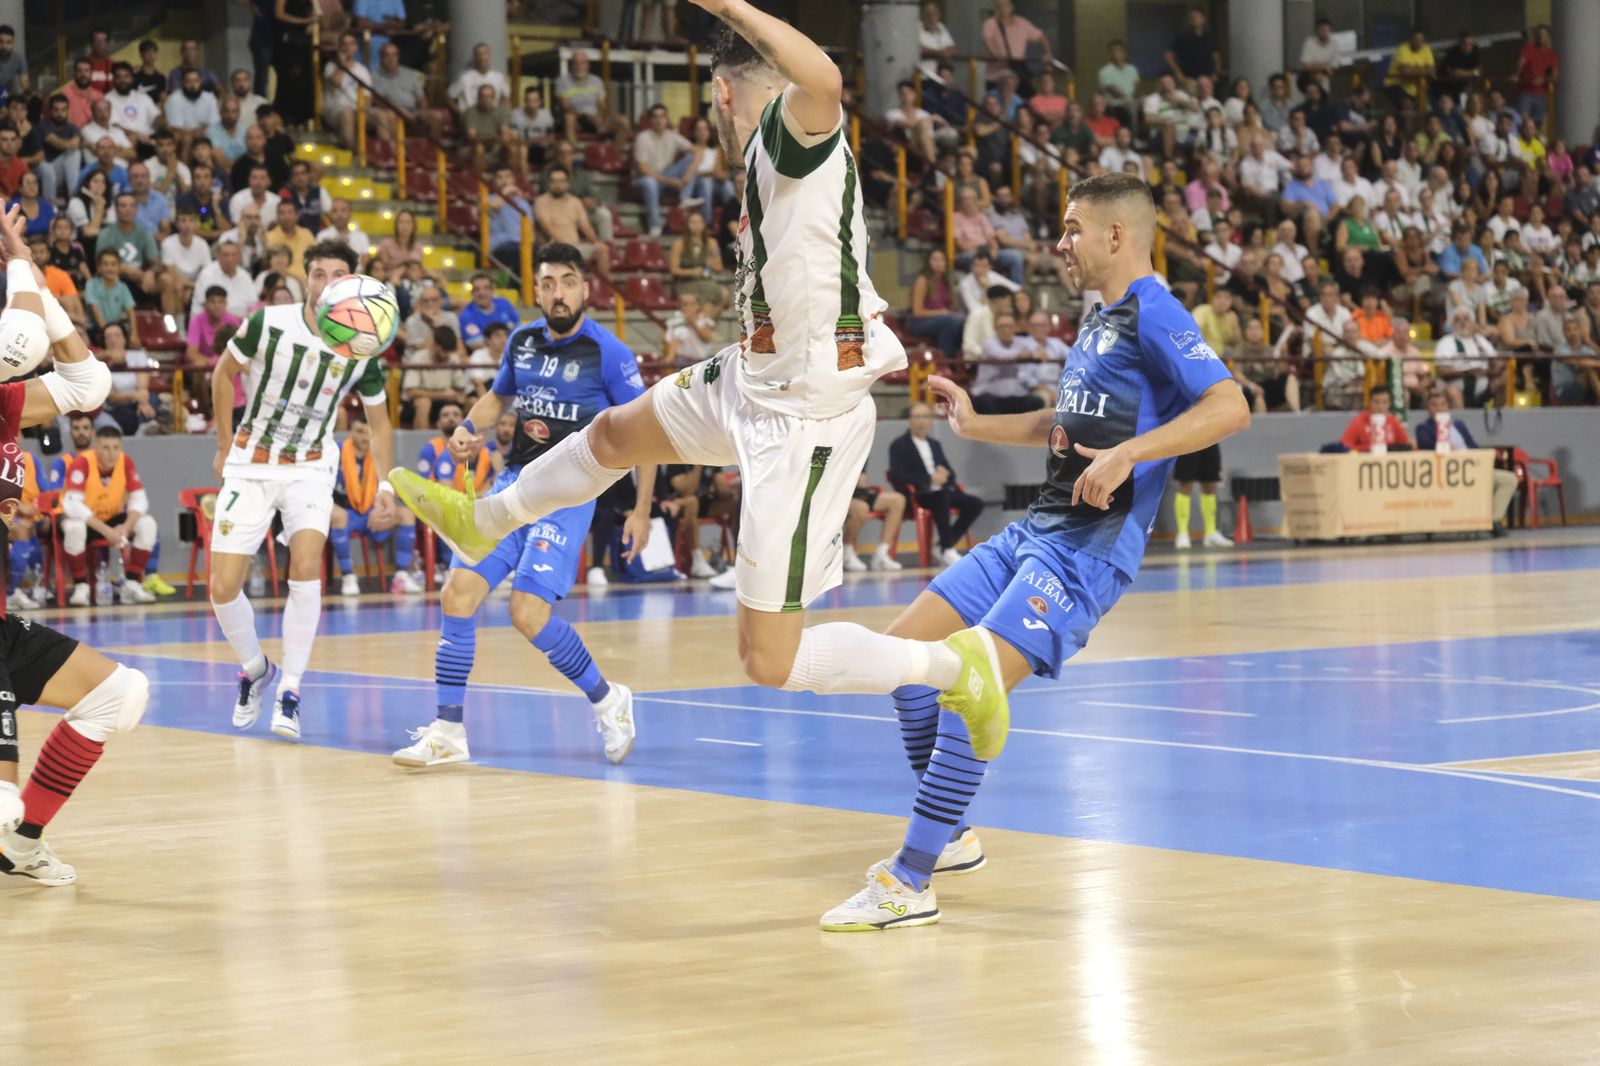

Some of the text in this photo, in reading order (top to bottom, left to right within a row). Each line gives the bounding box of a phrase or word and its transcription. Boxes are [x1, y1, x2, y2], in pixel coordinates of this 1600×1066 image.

[539, 355, 559, 378] 19
[224, 490, 240, 512] 7
[1022, 571, 1075, 613] ALBALI
